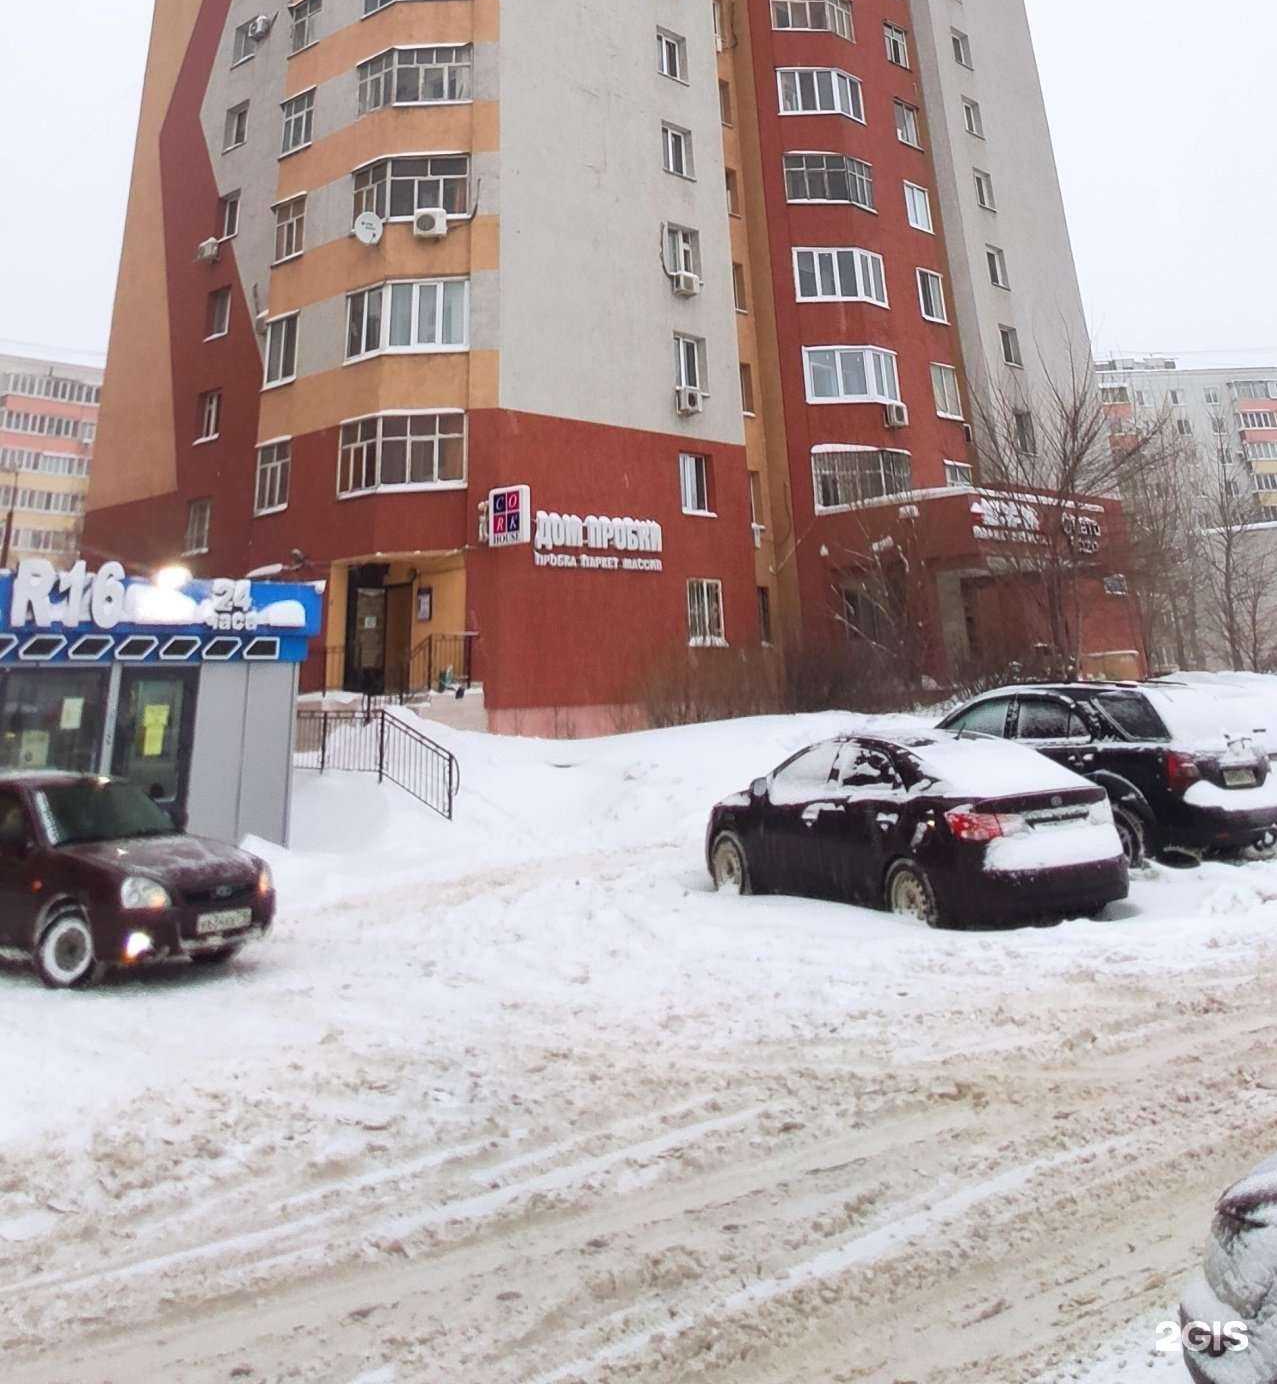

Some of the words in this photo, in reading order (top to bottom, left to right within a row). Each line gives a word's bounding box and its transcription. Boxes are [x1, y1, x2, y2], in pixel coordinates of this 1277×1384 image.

[494, 533, 520, 545] HOUSE
[535, 512, 583, 549] ДОМ
[585, 516, 662, 552] ПРОБКИ
[535, 552, 577, 567] ПРОБКА
[580, 554, 618, 569] ПАРКЕТ
[11, 559, 125, 629] R16
[212, 578, 251, 612] 24
